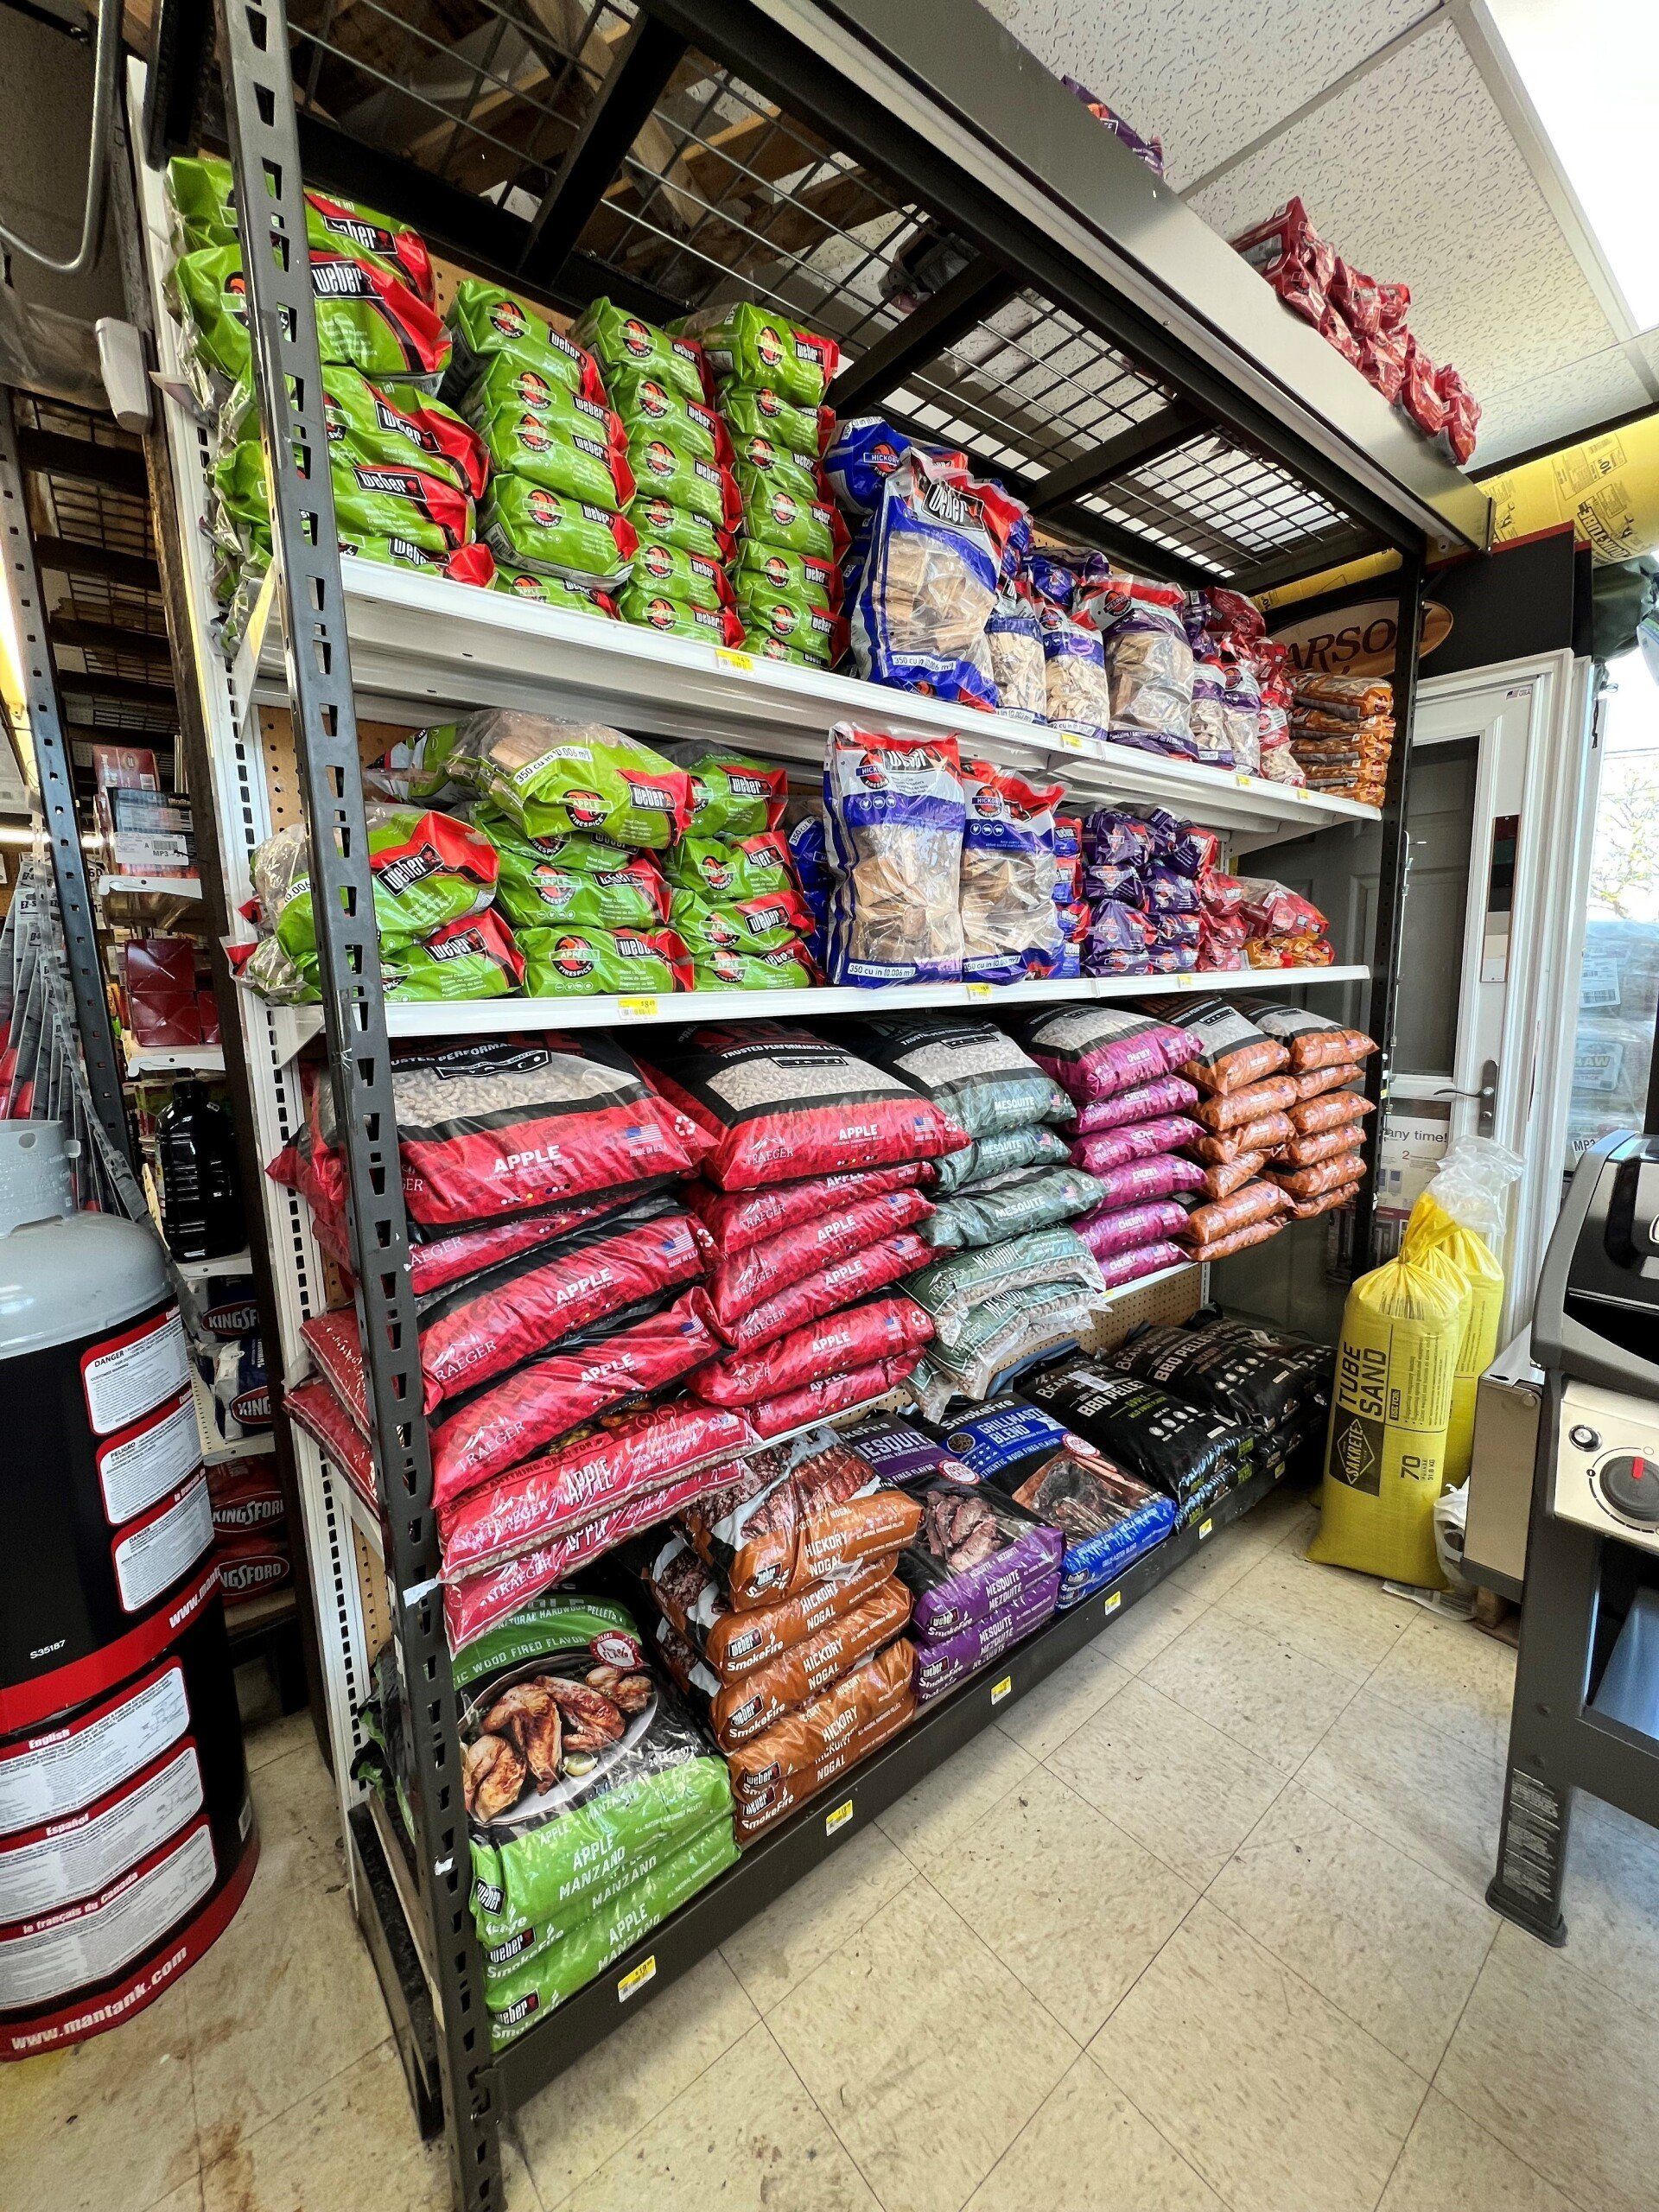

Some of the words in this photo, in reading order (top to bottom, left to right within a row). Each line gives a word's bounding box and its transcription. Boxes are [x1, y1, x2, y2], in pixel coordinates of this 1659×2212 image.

[312, 262, 362, 293] weber
[551, 333, 581, 361] weber
[575, 397, 604, 422] weber
[688, 405, 710, 429] weber
[575, 435, 604, 460] weber
[359, 471, 406, 493] weber
[695, 462, 719, 484] weber
[582, 503, 610, 525] weber
[692, 561, 714, 579] weber
[805, 568, 826, 584] weber
[696, 612, 720, 628] weber
[812, 616, 833, 634] weber
[516, 767, 534, 784] 350
[533, 760, 545, 770] cu
[544, 753, 554, 765] in
[633, 784, 664, 807] weber
[732, 776, 761, 795] weber
[573, 799, 600, 810] APPLE
[569, 812, 605, 829] FIRESPICE
[791, 830, 803, 845] 350
[384, 855, 427, 891] weber
[540, 891, 574, 906] FIRESPICE
[749, 909, 779, 933] weber
[431, 937, 471, 959] weber
[561, 949, 590, 959] APPLE
[558, 964, 593, 978] FIRESPICE
[715, 960, 740, 969] APPLE
[849, 965, 862, 975] 350
[865, 967, 874, 976] cu
[874, 967, 883, 976] in
[977, 961, 987, 969] cu
[721, 1044, 763, 1059] TRUSTED
[995, 1096, 1035, 1110] MESQUITE
[839, 1123, 878, 1141] APPLE
[1414, 1128, 1448, 1144] time!
[493, 1144, 560, 1173] APPLE
[746, 1147, 794, 1165] TRAEGER
[982, 1139, 1022, 1155] MESQUITE
[1402, 1150, 1410, 1160] 2
[740, 1205, 786, 1230] TRAEGER
[995, 1196, 1046, 1218] MESQUITE
[817, 1214, 857, 1241] APPLE
[1118, 1212, 1146, 1230] CHERRY
[972, 1242, 1025, 1272] MESQUITE
[1109, 1254, 1136, 1271] CHERRY
[734, 1265, 779, 1300] TRAEGER
[825, 1260, 863, 1286] APPLE
[928, 1268, 968, 1297] TRAEGER
[556, 1268, 613, 1304] APPLE
[738, 1308, 787, 1342] TRAEGER
[811, 1331, 851, 1352] APPLE
[94, 1350, 125, 1369] DANGER
[581, 1353, 636, 1383] APPLE
[1153, 1358, 1184, 1382] BBQ
[1338, 1341, 1362, 1405] TUBE
[1359, 1347, 1388, 1417] SAND
[940, 1398, 1015, 1431] SmokeFire
[1077, 1396, 1111, 1417] BBQ
[976, 1407, 1046, 1435] GRILLMASTE
[454, 1421, 525, 1471] TRAEGER
[857, 1431, 930, 1461] ESQUIT
[992, 1425, 1032, 1446] BLEND
[110, 1441, 137, 1459] PELIGRO
[1006, 1449, 1023, 1464] WOOD
[1022, 1442, 1039, 1457] FIRED
[1039, 1437, 1061, 1452] FLAVOR
[1344, 1424, 1364, 1478] SAKRETE
[911, 1463, 936, 1478] FLAVOR
[1400, 1454, 1421, 1481] 70
[564, 1456, 615, 1507] APPLE
[129, 1526, 152, 1545] DANGER
[803, 1530, 849, 1559] HICKORY
[219, 1562, 283, 1590] NGSFORD
[491, 1557, 554, 1604] TRAEGER
[969, 1560, 993, 1579] MESQUITE
[985, 1568, 1020, 1598] MESQUITE
[800, 1580, 840, 1614] HICKORY
[988, 1582, 1023, 1611] MEZQUITE
[806, 1603, 837, 1632] NOGAL
[927, 1615, 974, 1637] SmokeFire
[932, 1612, 952, 1627] weber
[978, 1613, 1013, 1644] MESQUITE
[29, 1639, 66, 1660] S35187
[472, 1651, 507, 1675] WOOD
[511, 1641, 543, 1658] FIRED
[545, 1635, 587, 1649] FLAVOR
[727, 1640, 785, 1673] SmokeFire
[730, 1634, 754, 1657] weber
[803, 1636, 845, 1674] HICKORY
[808, 1661, 841, 1691] NOGAL
[918, 1663, 964, 1689] SmokeFire
[922, 1662, 944, 1678] weber
[835, 1674, 862, 1696] HICKORY
[728, 1701, 786, 1738] SmokeFire
[733, 1705, 756, 1726] weber
[822, 1705, 859, 1744] HICKORY
[28, 1727, 72, 1751] English
[746, 1769, 772, 1786] weber
[817, 1753, 847, 1783] NOGAL
[741, 1792, 794, 1831] SmokeFire
[45, 1812, 90, 1838] Español
[540, 1822, 573, 1847] APPLE
[573, 1832, 614, 1872] APPLE
[559, 1845, 626, 1902] MANZANO
[592, 1855, 658, 1910] MANZANO
[22, 1923, 34, 1935] le
[36, 1904, 82, 1931] français
[85, 1899, 99, 1912] du
[100, 1870, 139, 1906] Canada
[608, 1902, 649, 1946] APPLE
[486, 1927, 564, 1980] SmokeFire
[488, 1936, 524, 1964] weber
[11, 1946, 188, 2050] www.mantank.com
[496, 2000, 528, 2026] weber
